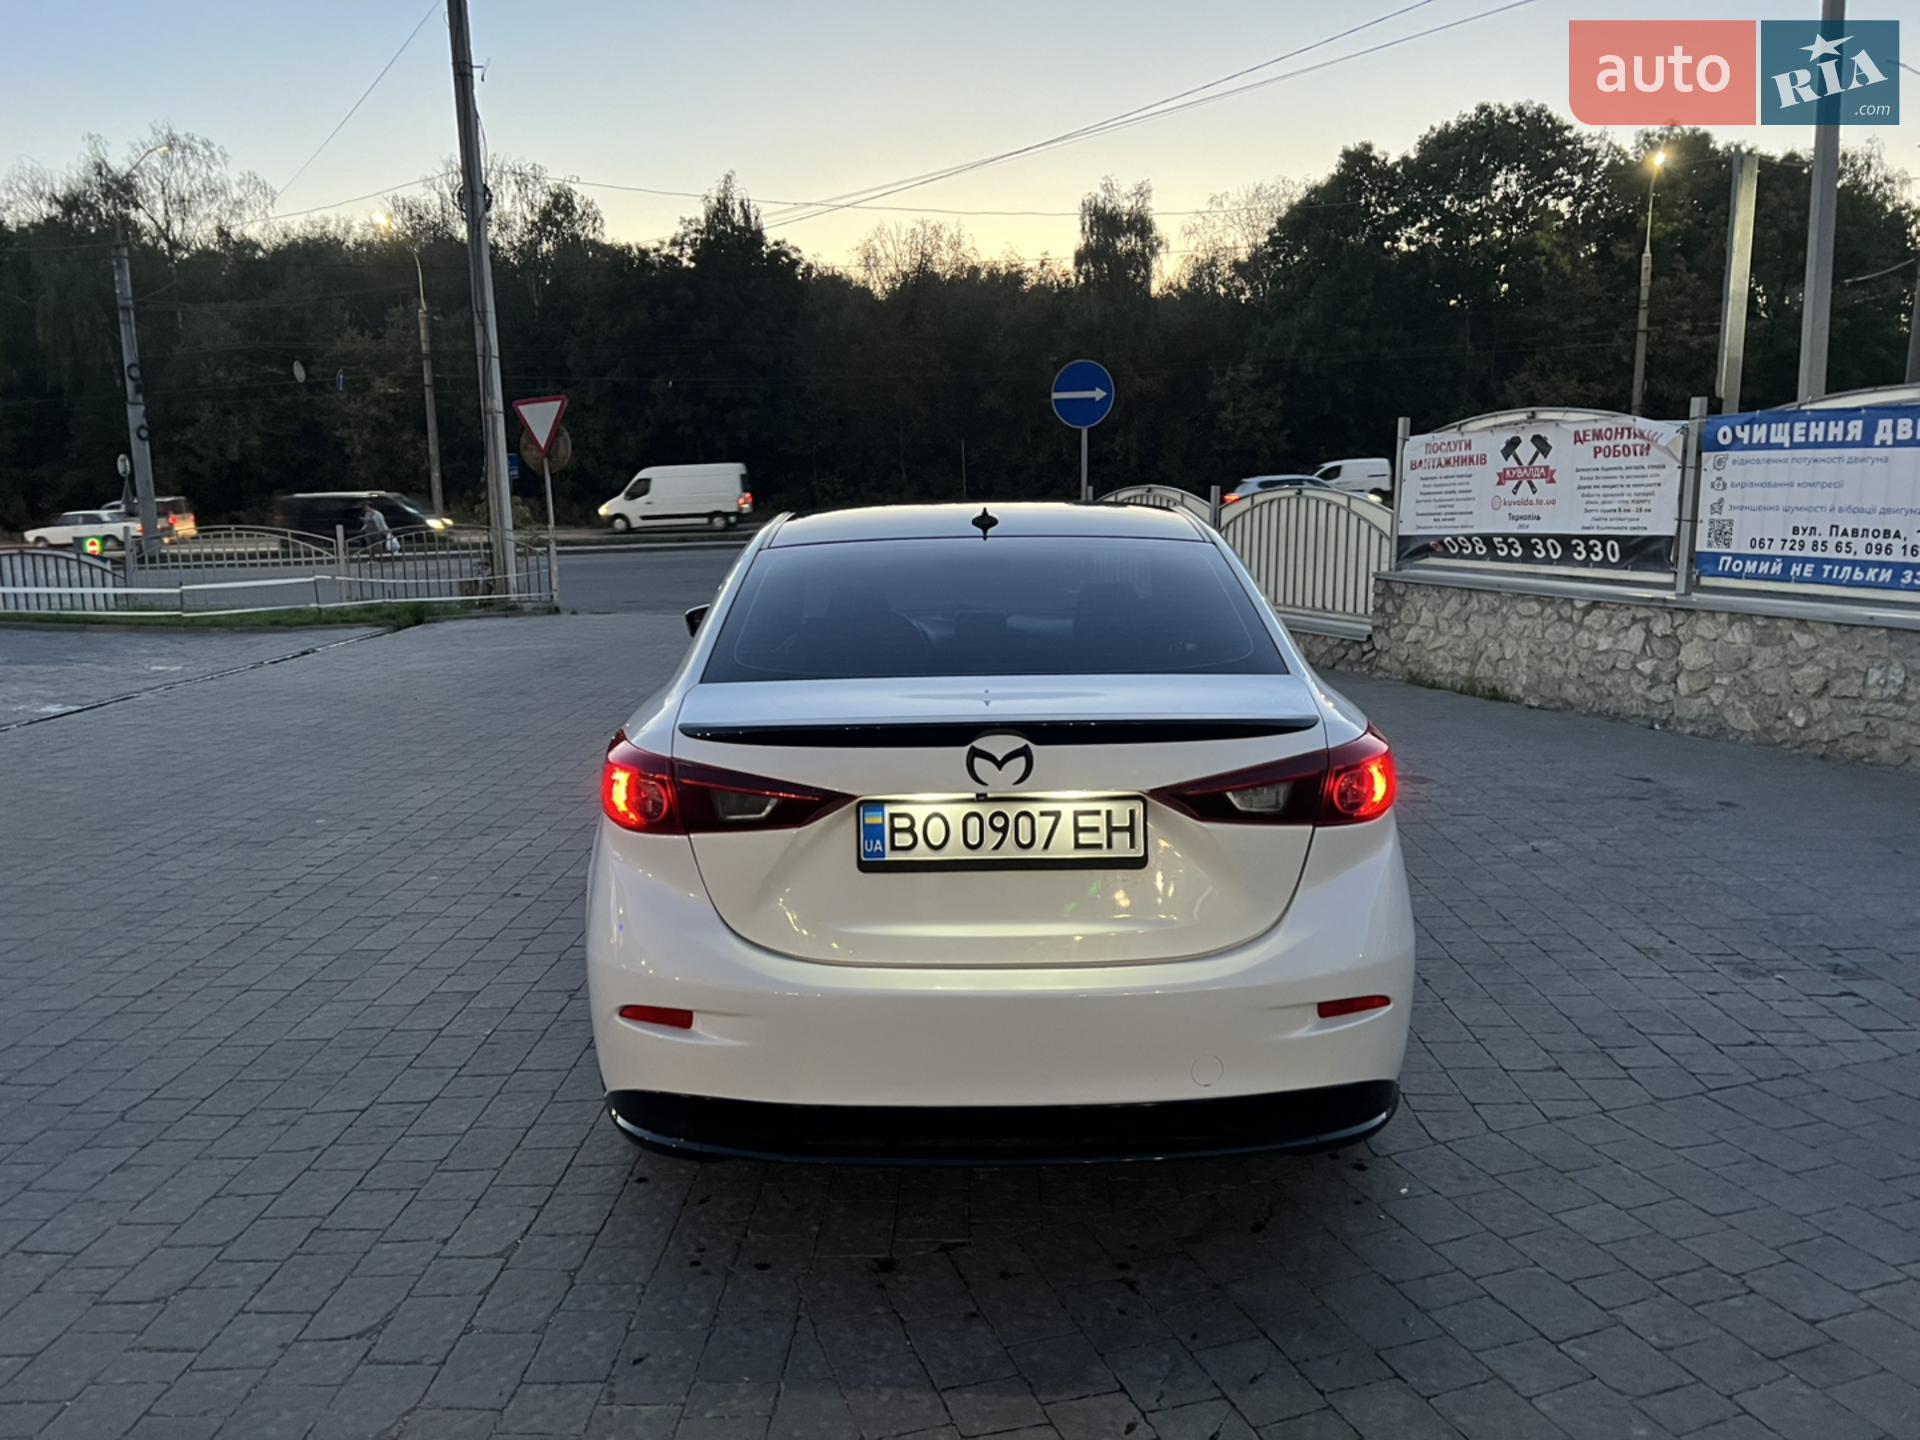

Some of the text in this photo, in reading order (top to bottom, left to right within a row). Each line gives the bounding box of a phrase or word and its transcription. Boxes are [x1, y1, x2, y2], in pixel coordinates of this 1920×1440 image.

[1717, 419, 1864, 448] ОЧИЩЕННЯ
[1425, 439, 1473, 455] ПОСЛУГИ
[1593, 443, 1652, 459] РОБОТИ
[1731, 454, 1889, 467] відновлення потужності двигуна
[1505, 466, 1547, 479] КУВАЛДА
[1730, 479, 1845, 490] вирівнювання компресії
[1728, 503, 1780, 512] зменшення
[1782, 503, 1827, 515] шумності
[1838, 504, 1877, 515] вібрації
[1443, 536, 1621, 563] 098 53 30 330
[1750, 537, 1775, 550] 067
[1780, 538, 1806, 551] 729
[1811, 539, 1829, 553] 85
[1834, 541, 1858, 556] 65,
[1865, 542, 1893, 556] 096
[962, 809, 1063, 851] 0907
[1072, 808, 1136, 849] EH
[864, 839, 883, 852] UA
